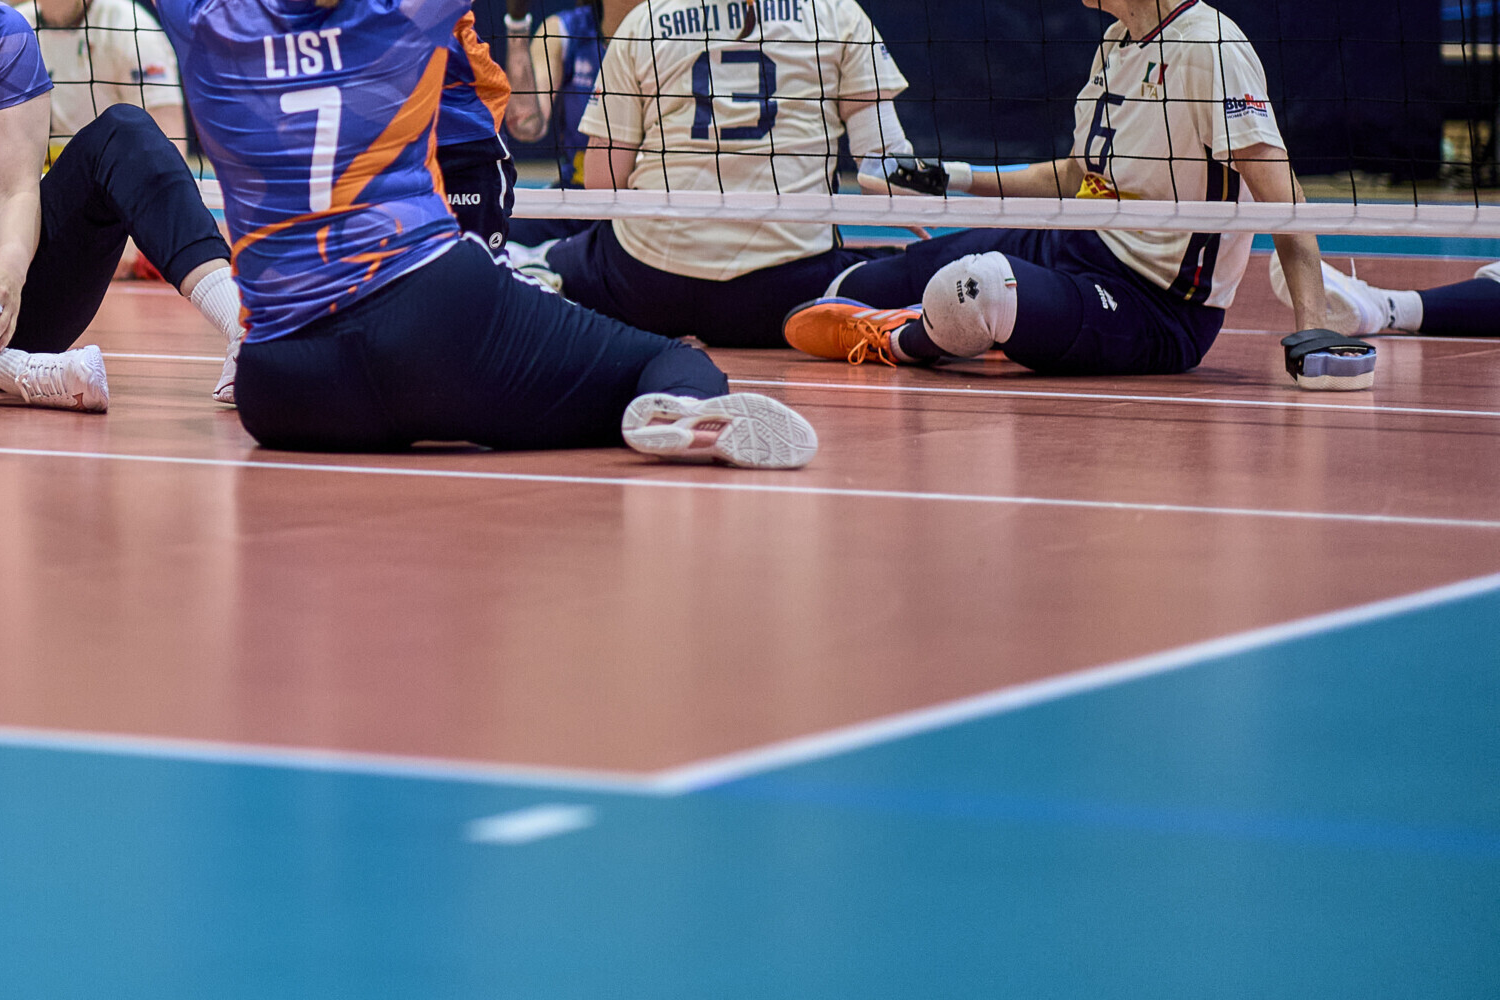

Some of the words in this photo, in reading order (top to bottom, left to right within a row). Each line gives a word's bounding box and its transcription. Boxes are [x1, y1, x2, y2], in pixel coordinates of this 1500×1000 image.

[658, 4, 720, 38] SARZI
[263, 27, 343, 79] LIST
[690, 50, 778, 140] 13
[1141, 83, 1159, 100] ITA
[279, 86, 342, 213] 7
[1084, 91, 1126, 175] 6
[447, 193, 481, 206] JAKO
